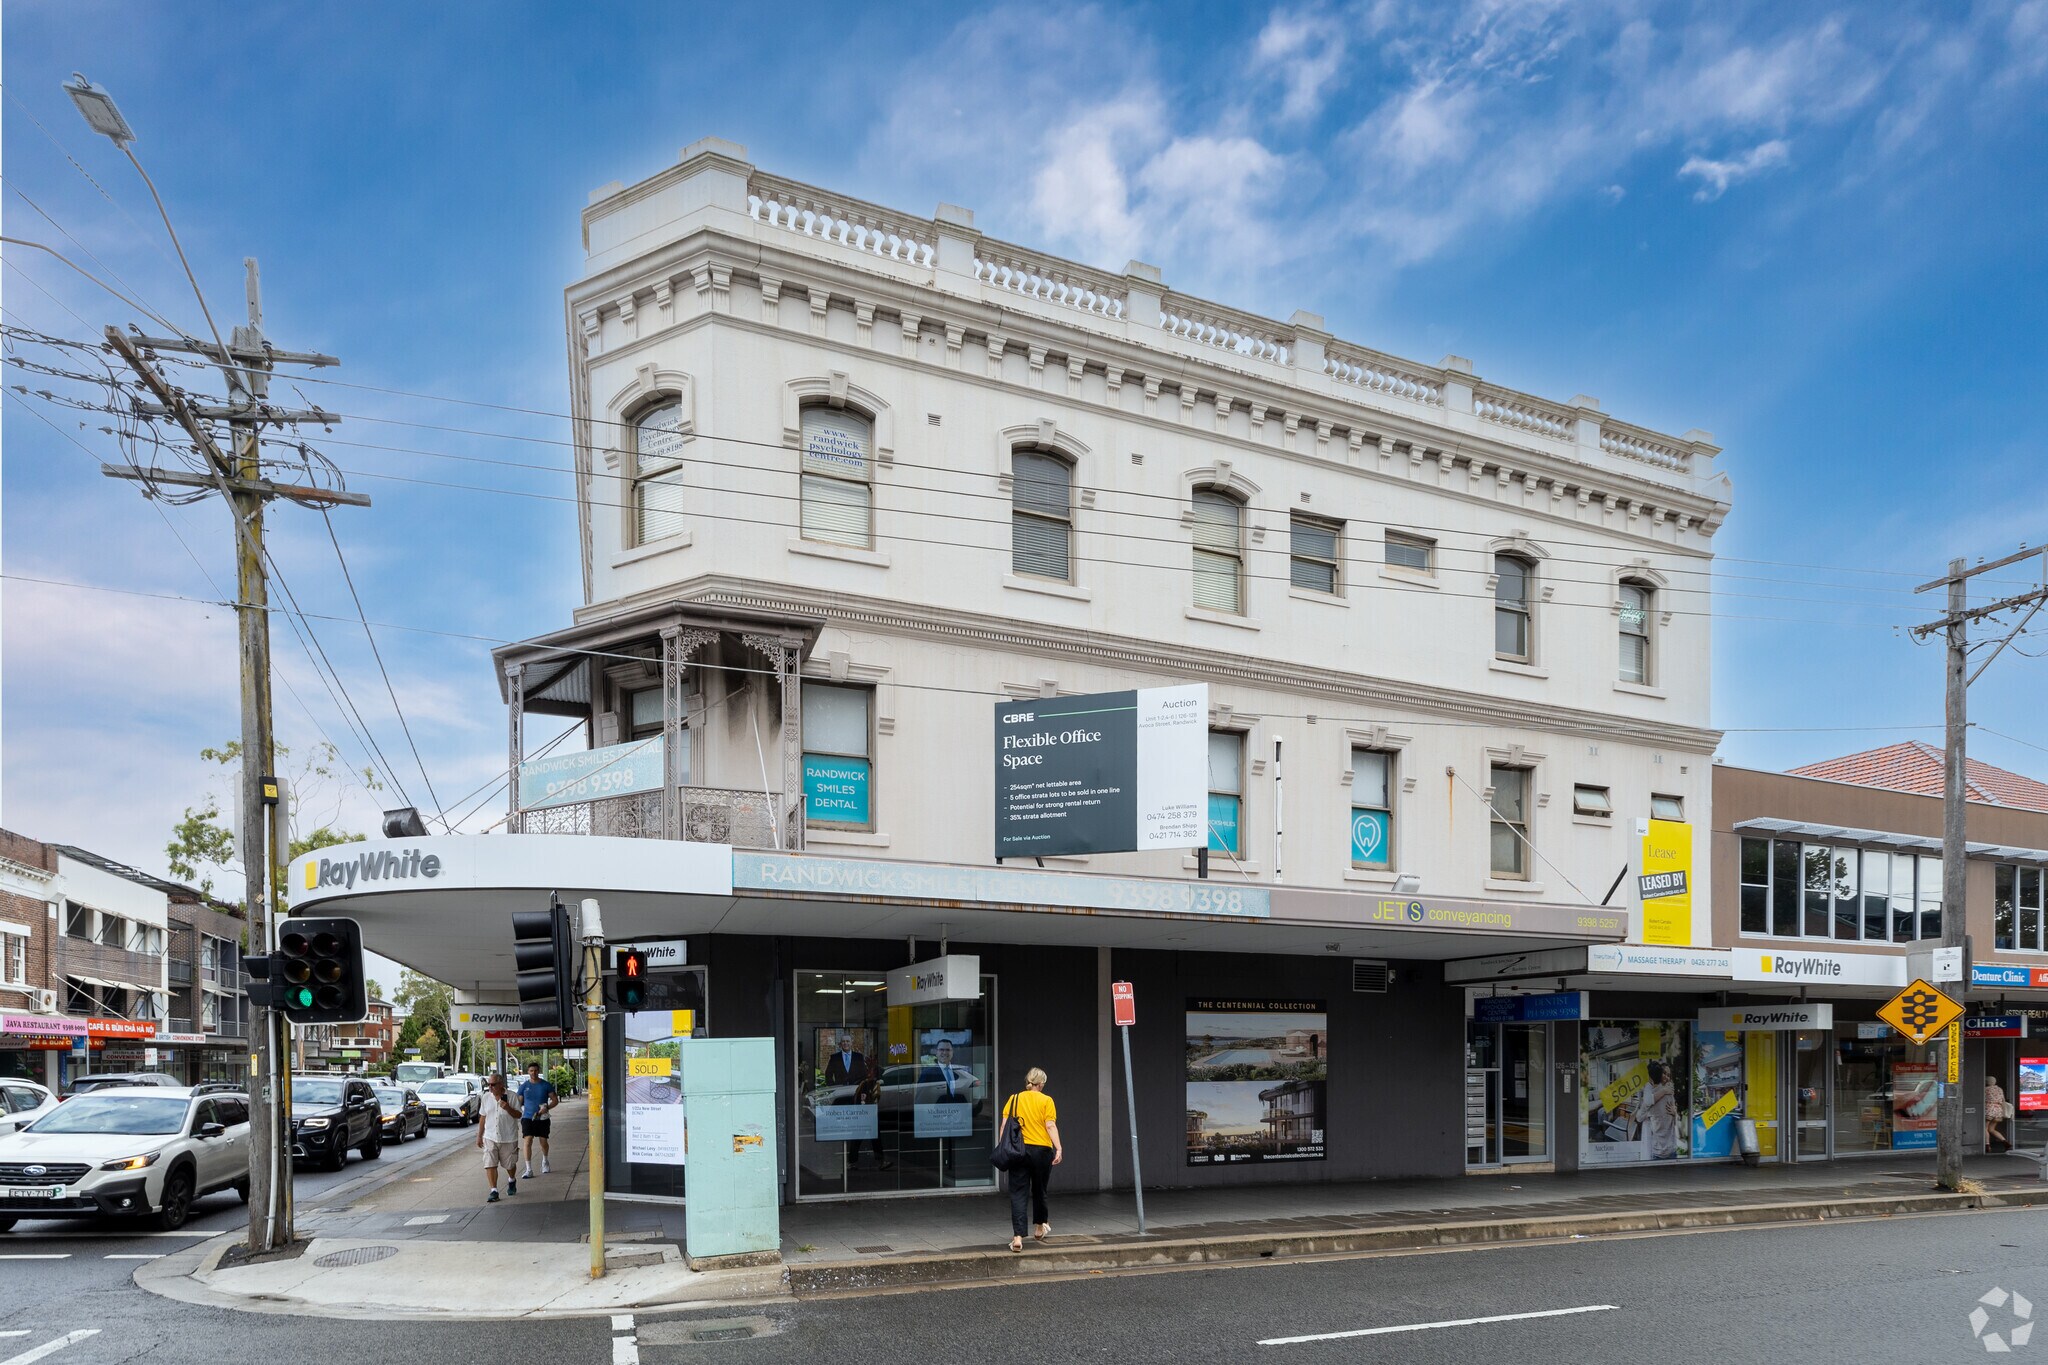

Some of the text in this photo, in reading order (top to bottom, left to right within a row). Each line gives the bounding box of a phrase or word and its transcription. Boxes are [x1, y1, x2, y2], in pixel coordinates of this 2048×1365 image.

[640, 425, 680, 443] Psychology
[823, 428, 849, 440] www.
[647, 436, 673, 448] Centre
[813, 435, 860, 450] randwick
[809, 442, 863, 460] psychology
[1162, 699, 1198, 709] Auction
[1003, 712, 1034, 724] CBRE
[1003, 728, 1102, 750] Flexible Office
[521, 757, 576, 777] RANDWICK
[578, 750, 616, 768] SMILES
[1003, 752, 1043, 770] Space
[806, 766, 865, 782] RANDWICK
[545, 768, 634, 798] 9398 9398
[816, 784, 855, 796] SMILES
[815, 797, 858, 810] DENTAL
[1146, 811, 1198, 821] 0474 258 379
[1149, 830, 1198, 840] 0421 714 362
[1648, 845, 1676, 860] Lease
[318, 848, 442, 890] RayWhite
[760, 862, 897, 890] RANDWICK
[901, 870, 986, 898] SMILES
[1109, 882, 1173, 908] 9398
[1180, 887, 1244, 914] 9398
[1642, 872, 1684, 891] LEASED BY
[1428, 907, 1512, 928] conveyancing
[1577, 917, 1597, 928] 9398
[1599, 918, 1618, 929] 5257
[1628, 956, 1657, 964] MASSAGE
[1659, 957, 1686, 965] THERAPY
[1774, 956, 1841, 977] RayWhite
[916, 972, 944, 992] RayWhite
[1972, 969, 2025, 982] Denture Clinic
[1535, 997, 1568, 1006] DENTIST
[1560, 1008, 1578, 1016] 9398
[1744, 1012, 1808, 1025] RayWhite
[2028, 1010, 2048, 1018] REALTY
[6, 1020, 22, 1029] JAVA
[22, 1021, 60, 1030] RESTAURANT
[88, 1021, 104, 1031] CAFÉ
[1966, 1019, 2007, 1028] Clinic
[635, 1064, 658, 1074] SOLD
[1612, 1074, 1642, 1104] SOLD
[1708, 1105, 1726, 1125] SOLD
[53, 1187, 62, 1198] P
